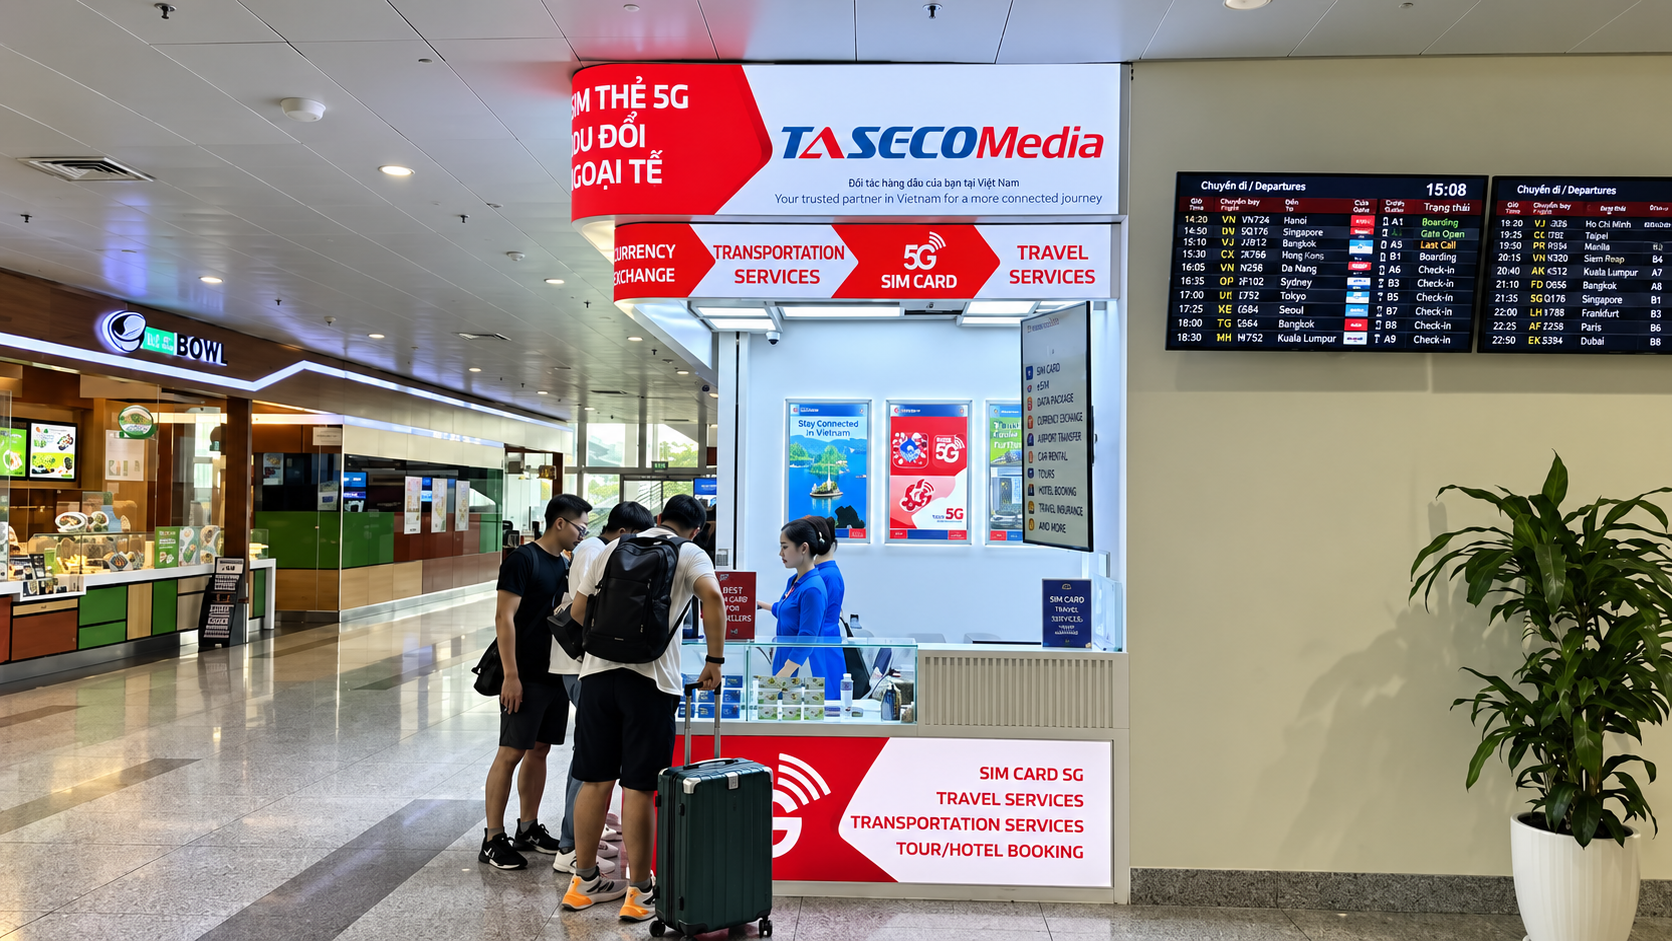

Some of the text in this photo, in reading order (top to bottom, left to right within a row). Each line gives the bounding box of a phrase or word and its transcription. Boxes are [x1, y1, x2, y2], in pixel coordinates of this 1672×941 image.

[594, 76, 646, 110] THẺ
[653, 84, 689, 109] 5G
[598, 111, 645, 149] ĐỔI
[998, 178, 1020, 187] Nam
[1255, 181, 1306, 193] Departures
[1426, 183, 1467, 196] 15:08
[1567, 185, 1617, 197] Departures
[775, 193, 1103, 206] Your trusted partner in Vietnam for a more connected journey
[1222, 215, 1236, 224] VN
[1422, 217, 1459, 229] Boarding
[1534, 219, 1546, 228] VJ
[1585, 220, 1597, 229] Ho
[1612, 220, 1632, 229] Minh
[1283, 228, 1324, 238] Singapore
[1222, 238, 1235, 247] VJ
[1282, 239, 1317, 249] Bangkok
[1532, 241, 1546, 250] PR
[713, 245, 845, 260] TRANSPORTATION
[903, 244, 937, 270] 5G
[1017, 245, 1089, 260] TRAVEL
[1221, 250, 1235, 259] CX
[1282, 250, 1303, 261] Hong
[1389, 251, 1401, 260] B1
[1419, 252, 1457, 263] Boarding
[1498, 253, 1522, 262] 20:15
[1532, 253, 1546, 262] VN
[1584, 254, 1603, 263] Siem
[1182, 263, 1455, 275] 16:05 VN Da Nang A6 Check-in
[1496, 266, 1663, 279] 20:40 AK Kuala Lumpur A7
[614, 267, 676, 286] EXCHANGE
[734, 269, 820, 284] SERVICES
[881, 274, 957, 289] SIM CARD
[1009, 269, 1095, 284] SERVICES
[1280, 277, 1313, 289] Sydney
[1387, 278, 1400, 288] B3
[1417, 278, 1454, 288] Check-in
[1495, 280, 1663, 292] 21:10 FD Bangkok A8
[1180, 290, 1205, 300] 17:00
[1280, 291, 1307, 302] Tokyo
[1416, 292, 1454, 302] Check-in
[1494, 293, 1661, 306] 21:35 SG Singapore B1
[1179, 304, 1204, 314] 17:25
[1279, 305, 1305, 315] Seoul
[1386, 306, 1398, 316] B7
[1415, 306, 1453, 316] Check-in
[1529, 308, 1543, 317] LH
[1581, 308, 1620, 318] Frankfurt
[1650, 309, 1662, 318] B3
[1178, 318, 1203, 328] 18:00
[1217, 319, 1232, 328] TG
[1278, 319, 1315, 331] Bangkok
[1414, 320, 1452, 330] Check-in
[1528, 322, 1542, 331] AF
[1581, 322, 1602, 332] Paris
[1650, 323, 1662, 332] B6
[1177, 333, 1451, 345] 18:30 MH Kuala Lumpur A9 Check-in
[1491, 336, 1516, 345] 22:50
[1528, 336, 1541, 345] EK
[1580, 336, 1605, 346] Dubai
[177, 333, 228, 366] BOWL
[817, 419, 859, 428] Connected
[816, 428, 850, 437] Vietnam
[936, 443, 960, 463] 5G
[945, 508, 964, 520] 5G
[980, 766, 1009, 780] SIM
[1013, 767, 1058, 781] CARD
[936, 791, 1084, 807] TRAVEL SERVICES
[850, 815, 1084, 833] TRANSPORTATION SERVICES
[896, 841, 1084, 859] TOUR/HOTEL BOOKING
